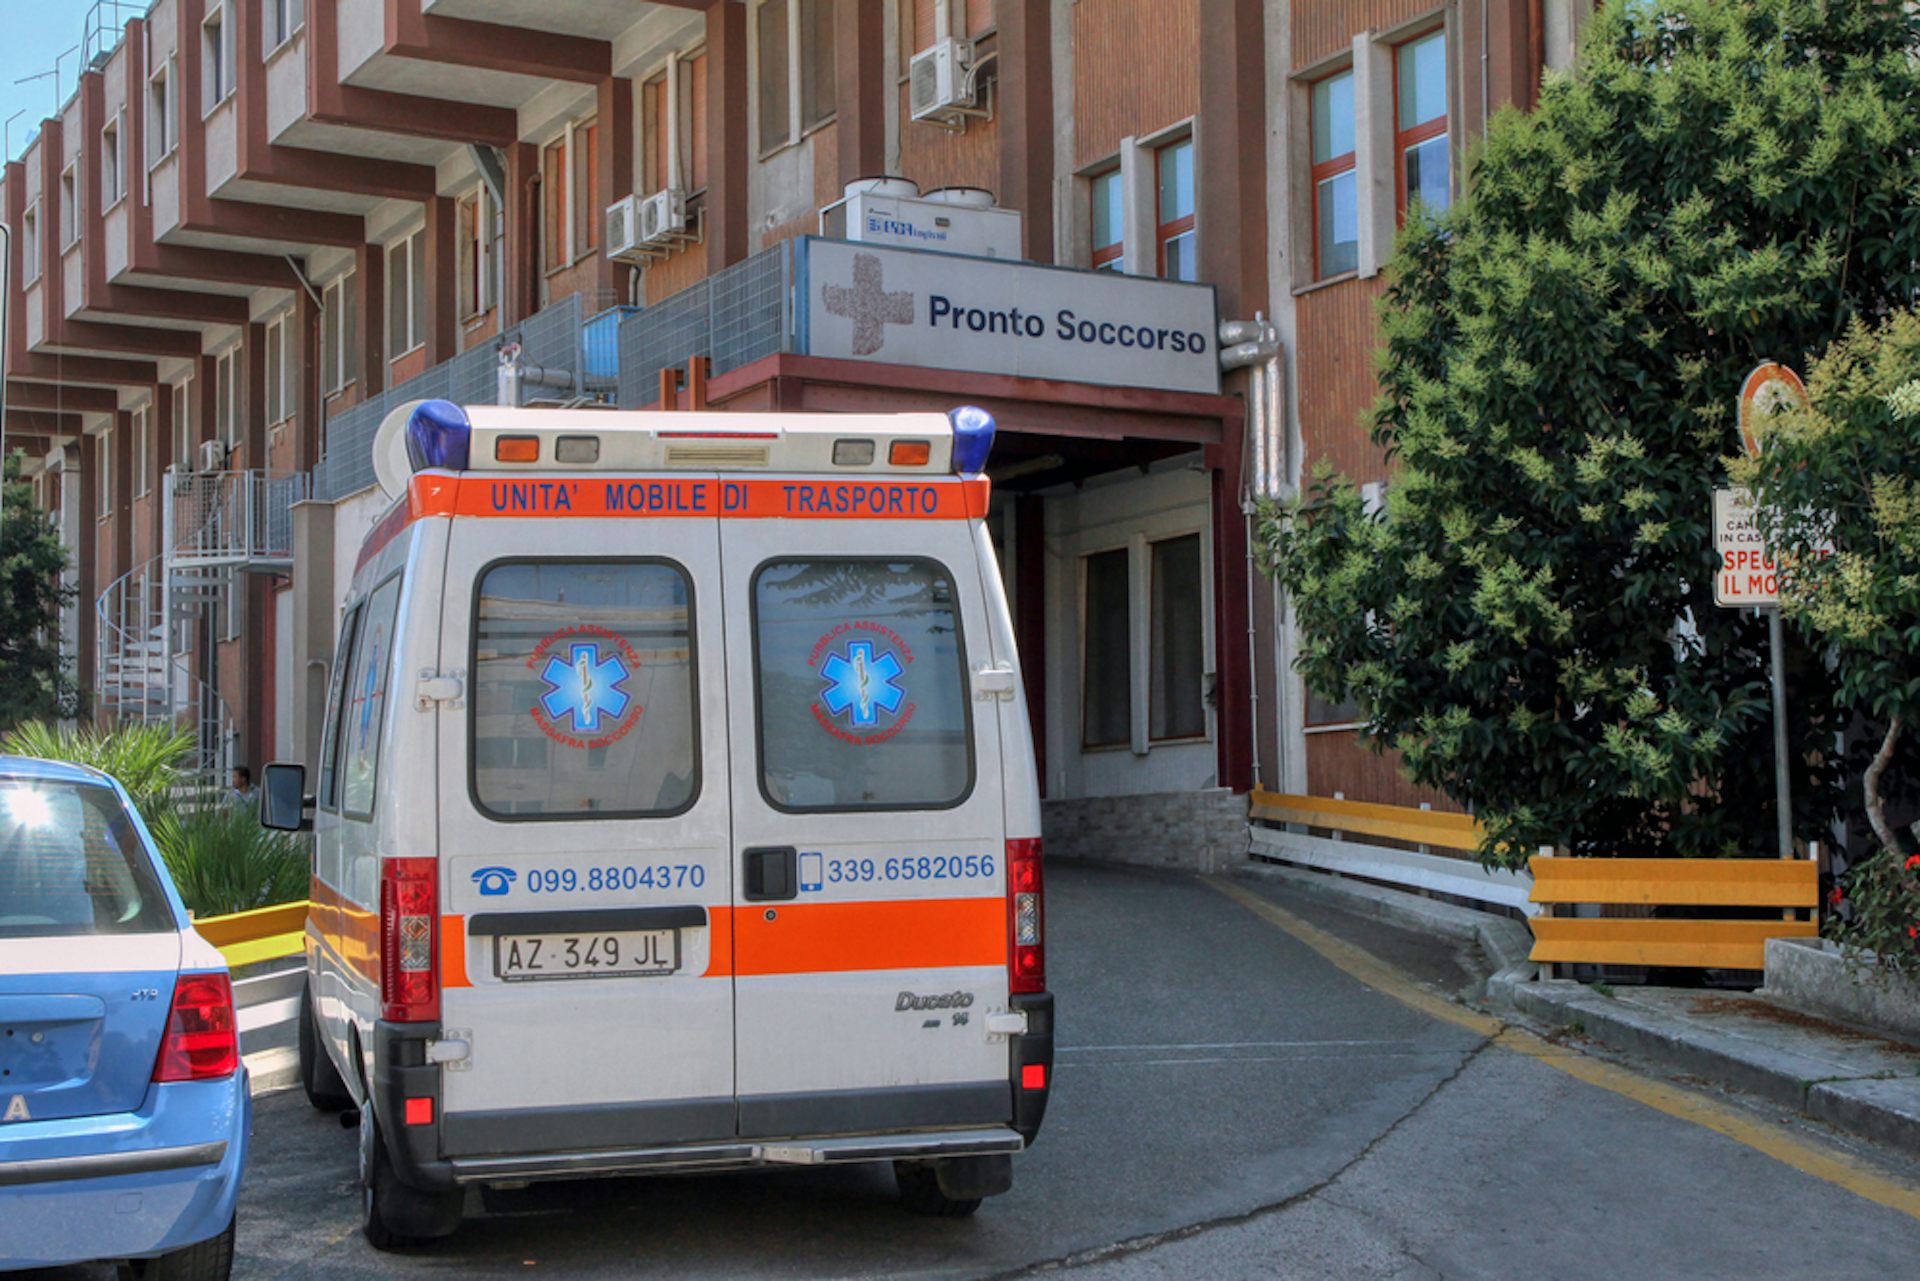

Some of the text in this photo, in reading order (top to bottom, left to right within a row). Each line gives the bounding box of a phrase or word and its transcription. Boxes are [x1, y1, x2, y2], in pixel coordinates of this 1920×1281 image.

[929, 295, 1206, 354] Pronto Soccorso
[492, 483, 939, 514] UNITA' MOBILE DI TRASPORTO
[1720, 534, 1733, 542] IN
[1724, 575, 1741, 594] IL
[526, 624, 641, 670] PUBBLICA ASSISTENZA
[807, 620, 916, 667] PUBBLICA ASSISTENZA
[588, 704, 645, 749] SOCCORSO
[864, 702, 917, 745] SOCCORSO
[527, 864, 705, 893] 099.8804370
[828, 854, 995, 883] 339.6582056
[507, 935, 668, 970] AZ 349 JL
[895, 990, 975, 1012] Ducato
